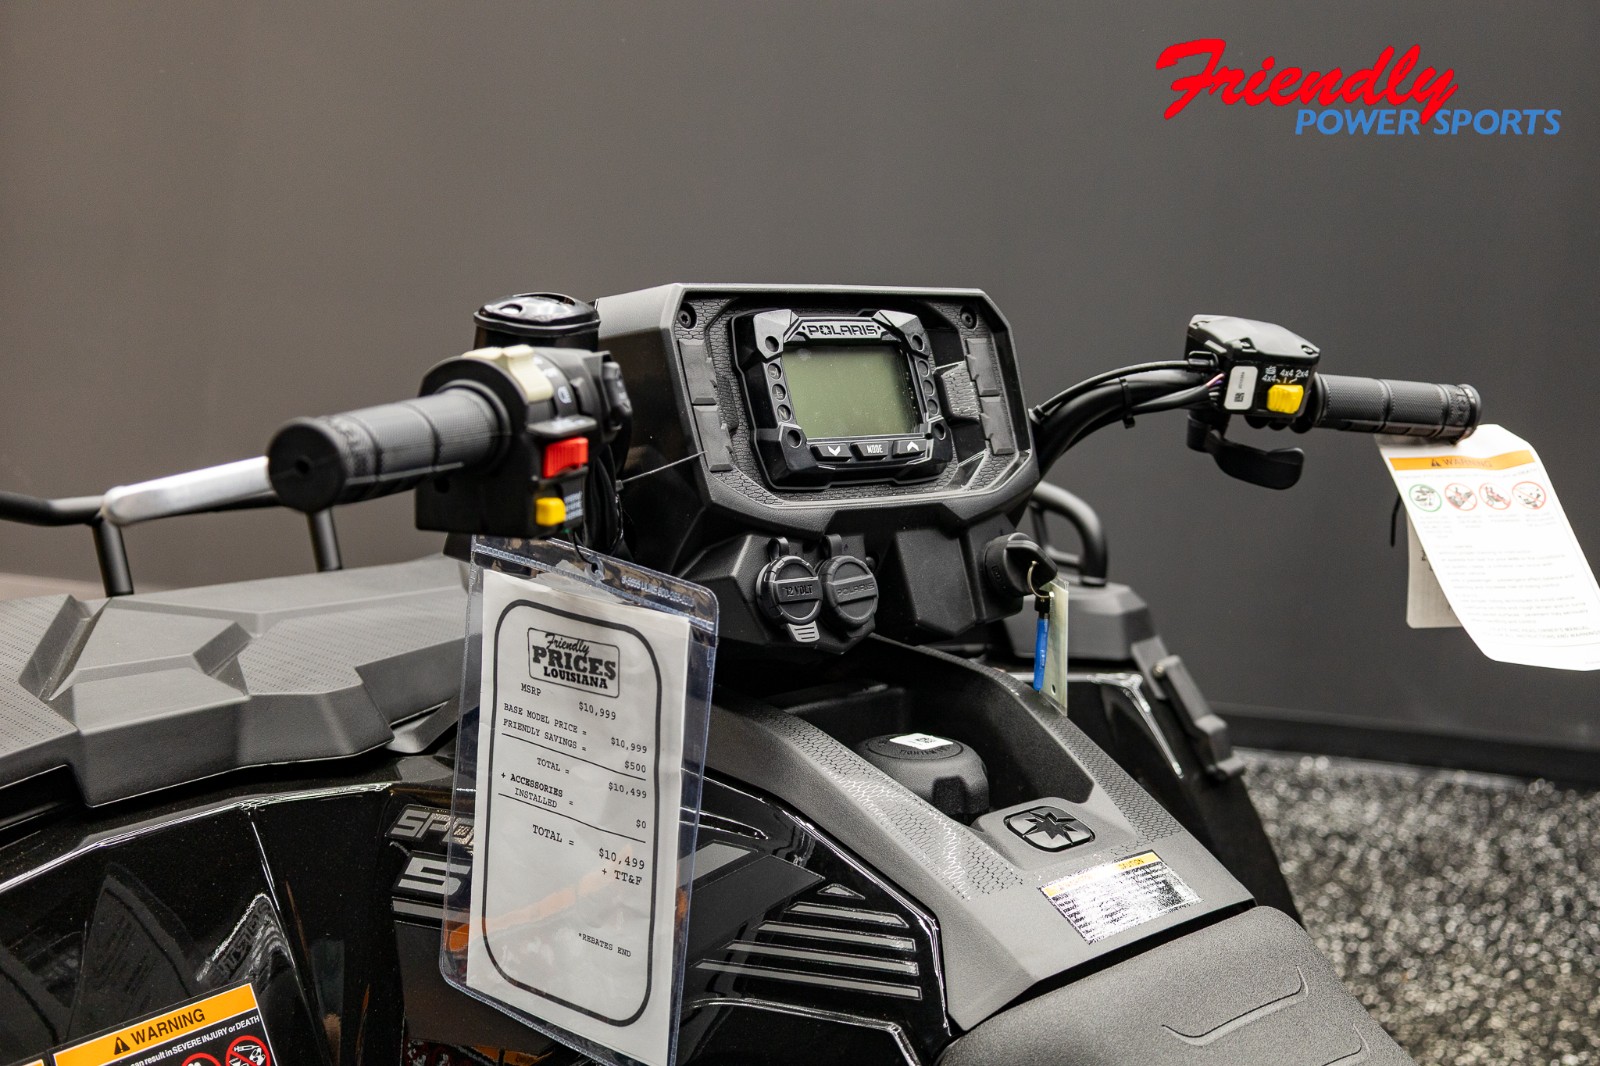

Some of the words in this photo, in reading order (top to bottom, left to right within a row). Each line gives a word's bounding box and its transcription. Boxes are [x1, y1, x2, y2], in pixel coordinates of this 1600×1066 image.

[806, 325, 878, 336] POLARIS
[545, 632, 589, 658] Friendly
[532, 645, 616, 680] PRICES
[544, 666, 608, 690] LOUISIANA
[521, 683, 541, 696] MSRP
[504, 703, 523, 715] BASE
[526, 710, 550, 724] MODEL
[554, 719, 578, 733] PRICE
[579, 701, 616, 720] $10,999
[503, 718, 540, 736] FRIENDLY
[544, 732, 577, 749] SAVINGS
[611, 737, 647, 753] $10,999
[537, 758, 560, 772] TOTAL
[624, 760, 646, 773] $500
[510, 774, 563, 798] ACCESSORIES
[608, 782, 647, 798] $10,499
[514, 788, 558, 808] INSTALLED
[532, 824, 562, 842] TOTAL
[636, 819, 646, 829] $0
[599, 848, 645, 870] $10,499
[614, 870, 642, 886] TT&F
[618, 946, 631, 958] END
[130, 1008, 206, 1045] WARNING
[144, 1051, 166, 1065] result
[172, 1036, 202, 1054] SEVERE
[202, 1028, 228, 1044] INJURY
[235, 1015, 260, 1030] DEATH
